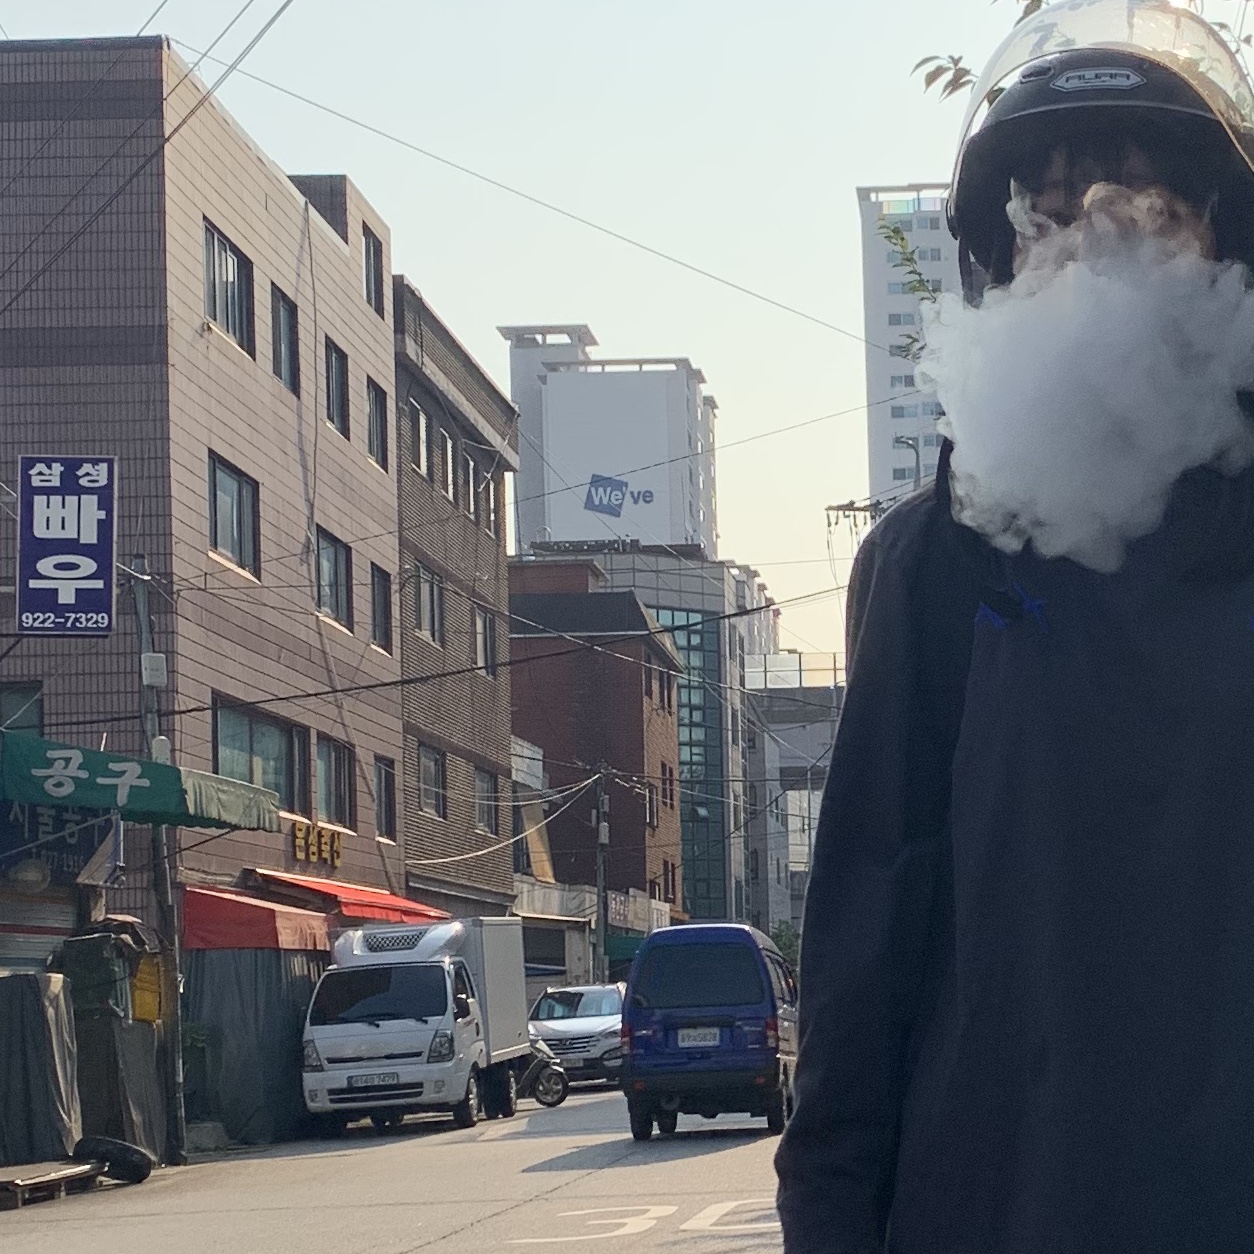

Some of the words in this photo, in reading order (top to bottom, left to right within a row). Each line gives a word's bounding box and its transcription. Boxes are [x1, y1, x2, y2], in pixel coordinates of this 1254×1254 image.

[28, 463, 109, 487] 삼성
[591, 486, 654, 505] We've
[28, 494, 107, 605] 빠우
[21, 611, 109, 629] 922-7329
[30, 748, 151, 807] 공구
